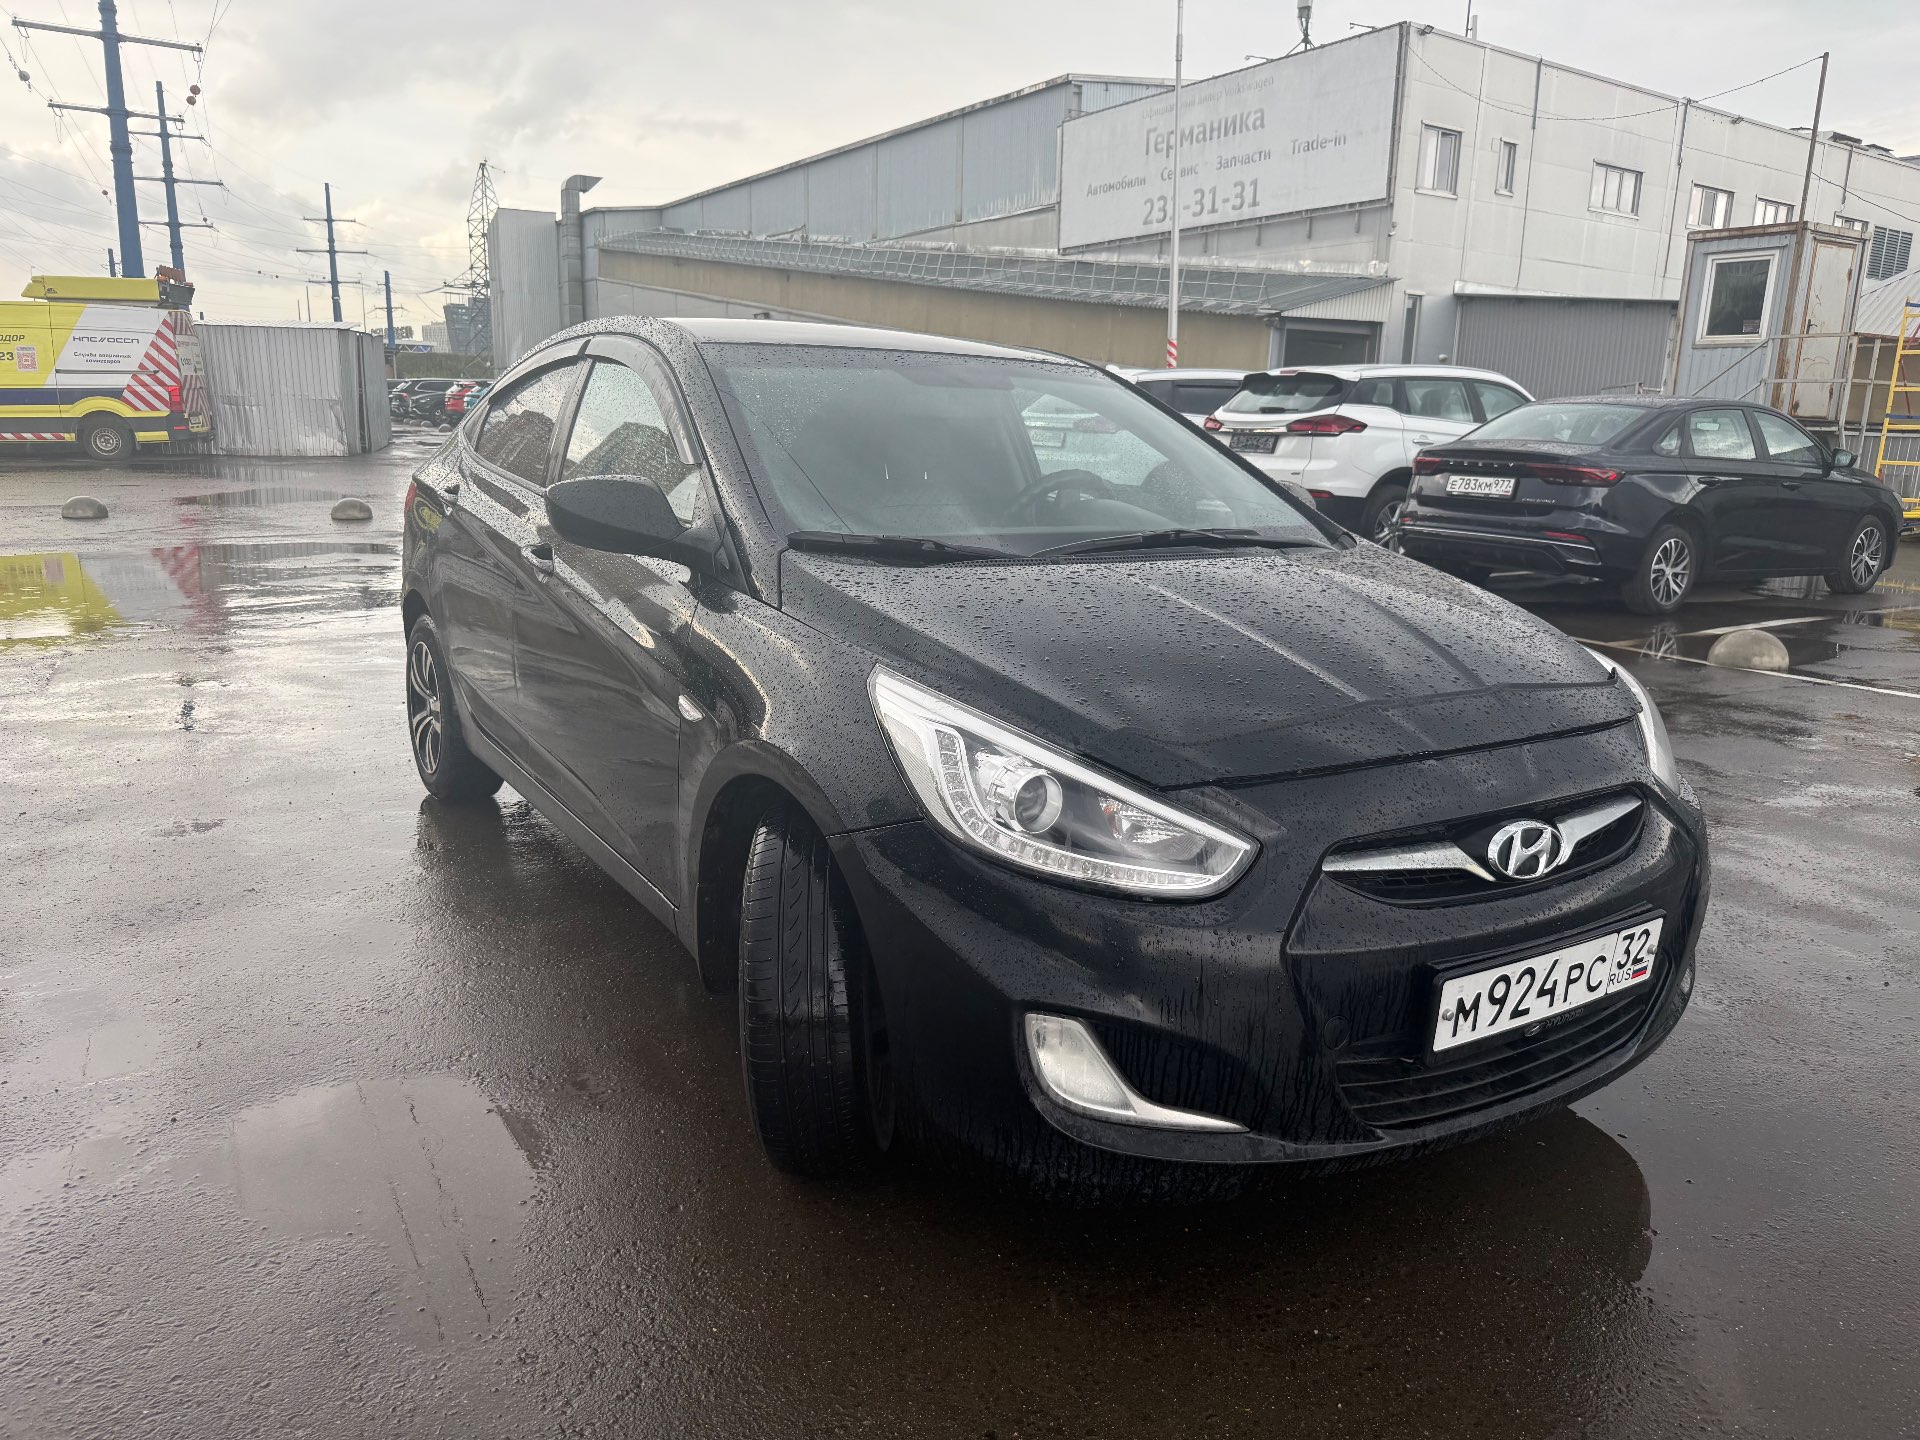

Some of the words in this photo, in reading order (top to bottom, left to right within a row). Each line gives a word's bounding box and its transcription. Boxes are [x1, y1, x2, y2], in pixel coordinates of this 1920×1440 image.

[1145, 107, 1265, 159] Германика
[1086, 175, 1147, 198] Автомобили
[1160, 163, 1199, 181] Севис
[1215, 149, 1271, 171] Запчасти
[1291, 130, 1347, 155] Trade-in
[1450, 478, 1492, 491] Е783КМ
[1493, 479, 1512, 490] 977
[1451, 955, 1607, 1037] М924РС
[1617, 928, 1650, 970] 32
[1609, 968, 1631, 986] RUS
